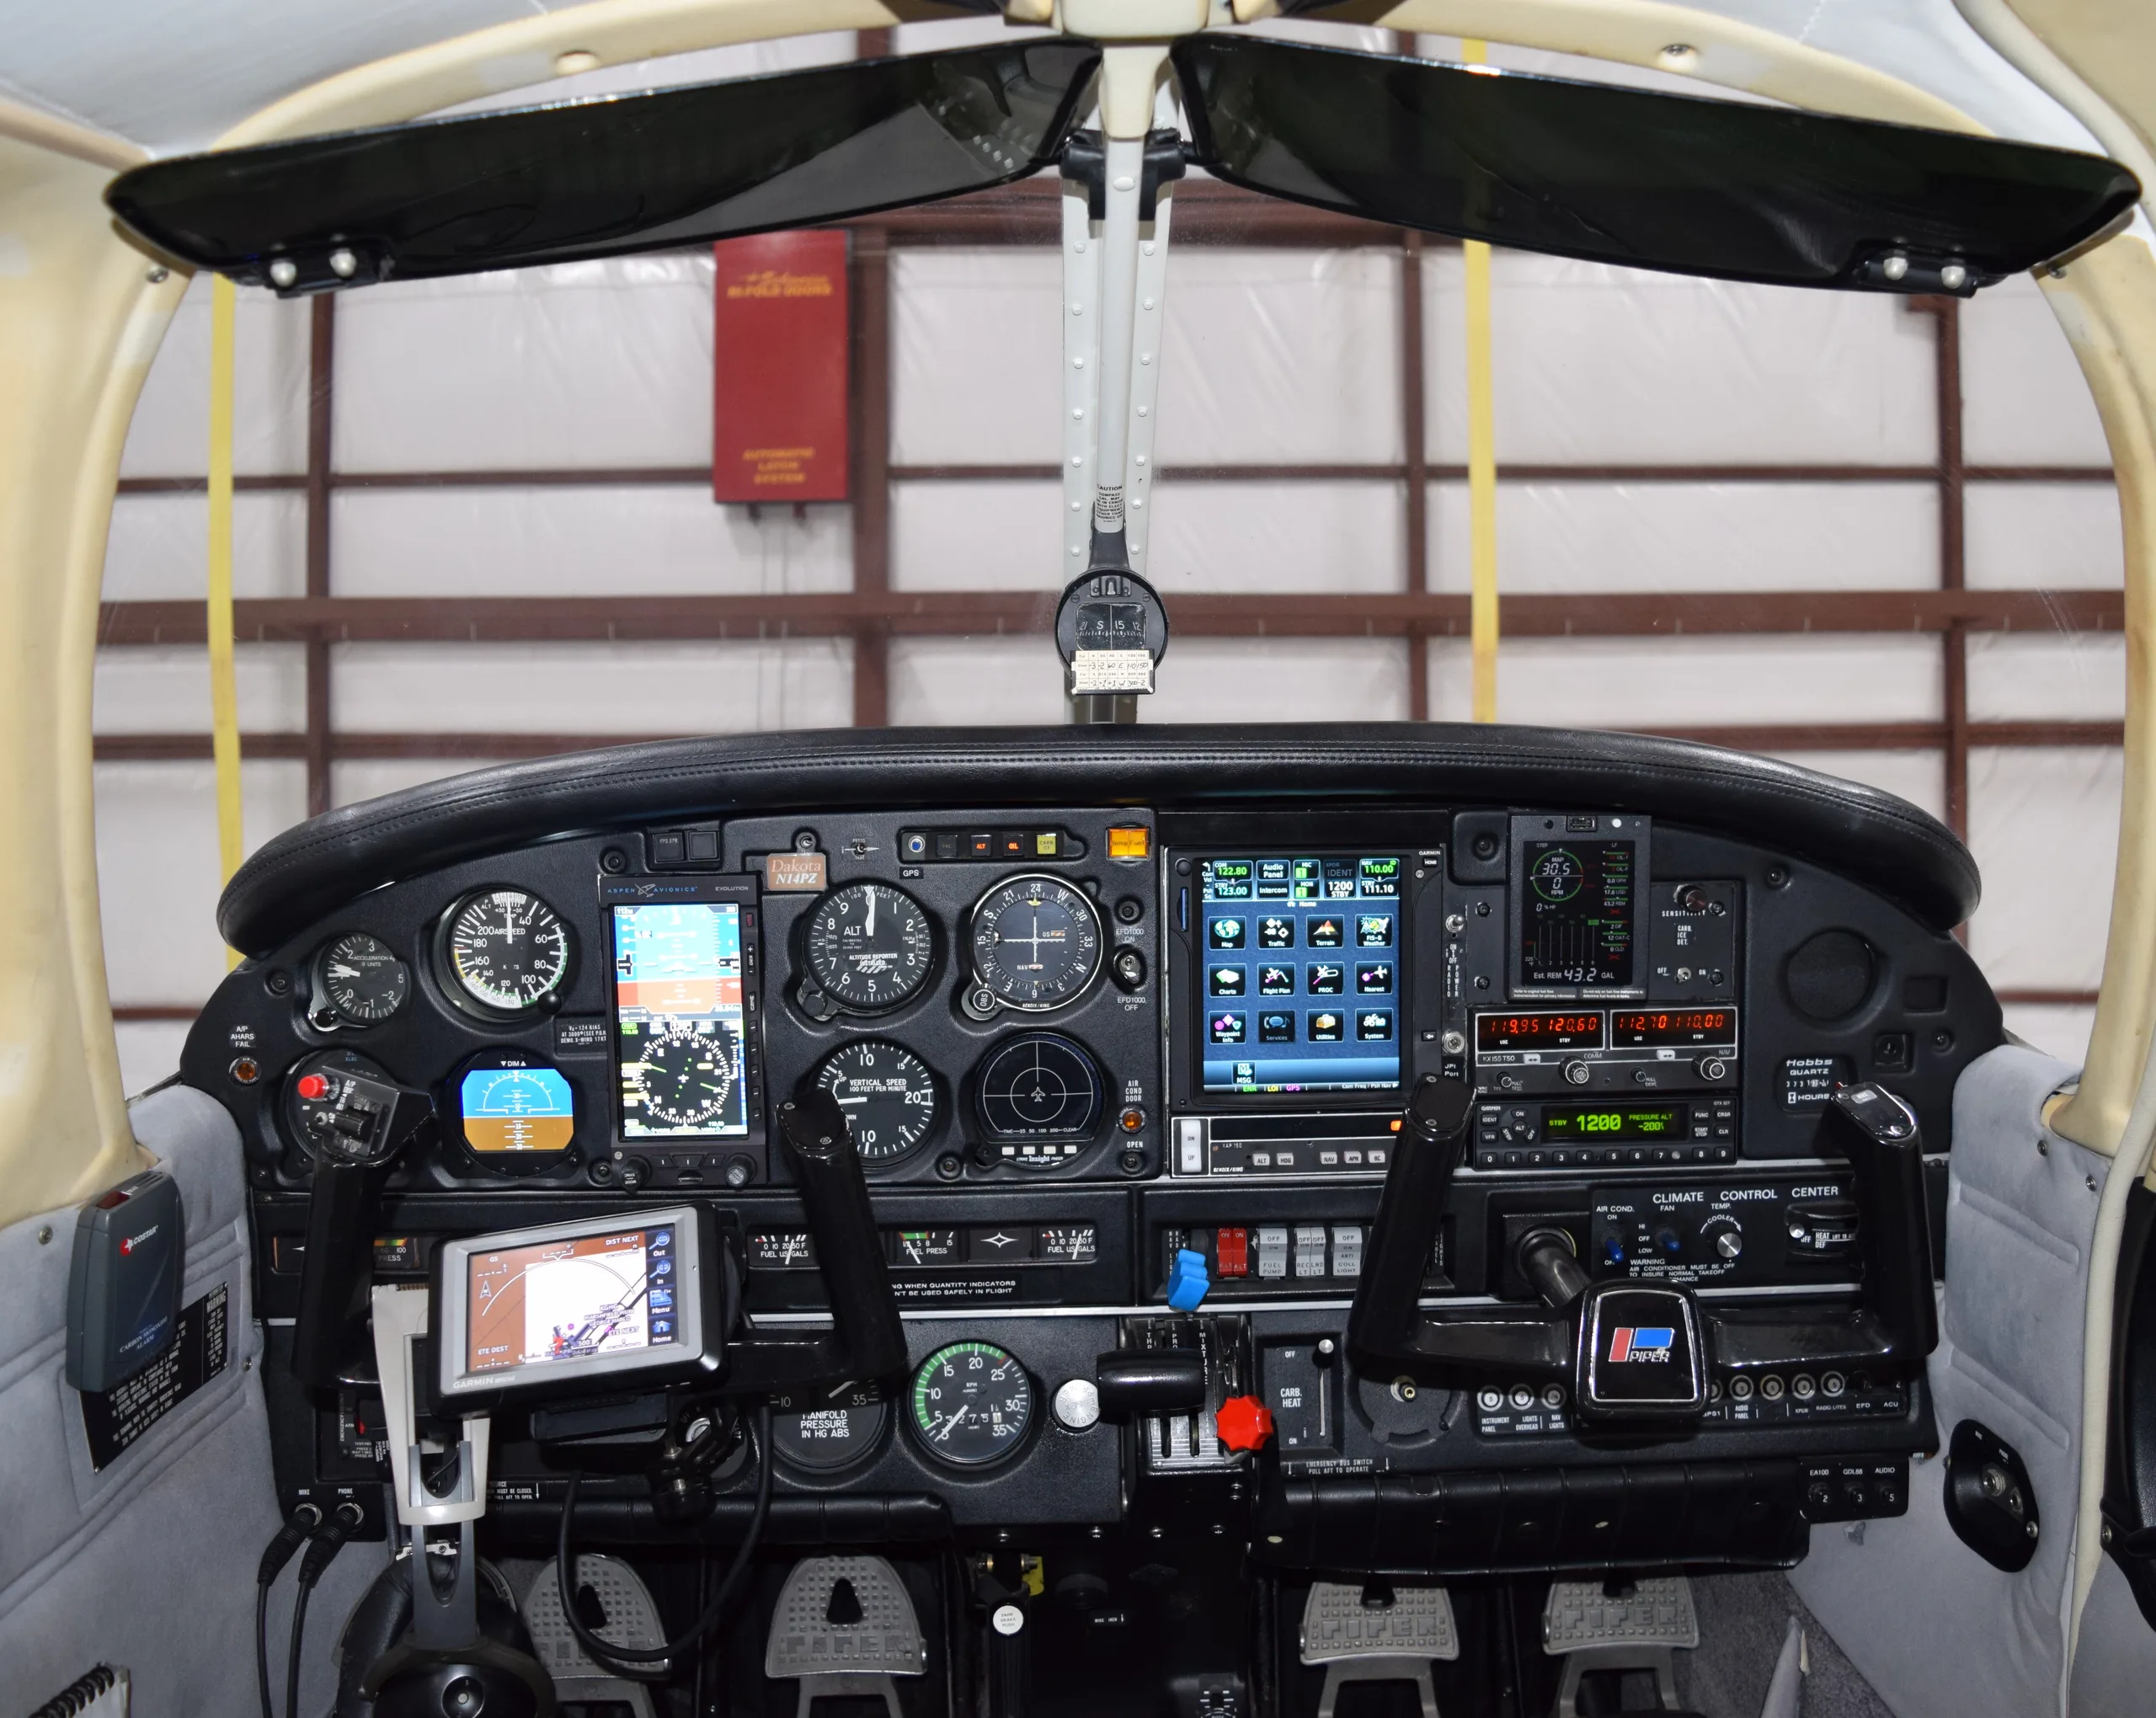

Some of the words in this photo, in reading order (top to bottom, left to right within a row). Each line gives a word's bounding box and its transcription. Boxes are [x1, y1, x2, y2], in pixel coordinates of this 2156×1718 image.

[742, 446, 815, 461] AUTOMATIC
[1097, 620, 1104, 630] S
[1114, 621, 1125, 630] 15
[771, 859, 822, 872] Dakota
[1364, 865, 1394, 874] 110.00
[1542, 862, 1571, 876] 30.5
[1217, 867, 1247, 876] 122.80
[1327, 868, 1353, 877] IDENT
[776, 872, 818, 884] N14PZ
[1030, 884, 1041, 893] 24
[1218, 887, 1247, 896] 123.00
[1328, 882, 1353, 891] 1200
[1364, 885, 1394, 894] 111.10
[519, 916, 531, 926] 40
[478, 926, 494, 936] 200
[843, 926, 862, 936] ALT
[473, 938, 488, 947] 180
[535, 934, 547, 944] 60
[475, 956, 490, 965] 160
[534, 959, 547, 969] 80
[521, 974, 536, 984] 100
[1563, 968, 1597, 982] 43.2
[979, 993, 989, 1006] OBS
[1491, 1018, 1540, 1033] 119.95
[1548, 1016, 1598, 1032] 120.60
[1619, 1015, 1668, 1031] 112.70
[1675, 1013, 1725, 1029] 110.00
[860, 1054, 874, 1066] 10
[1785, 1058, 1833, 1067] Hobbs
[1790, 1068, 1829, 1076] QUARTZ
[905, 1091, 921, 1104] 20
[1576, 1114, 1621, 1131] 1200
[1126, 1140, 1144, 1149] OPEN
[1028, 1155, 1050, 1164] Insight
[1652, 1192, 1705, 1204] CLIMATE
[1720, 1189, 1778, 1202] CONTROL
[1791, 1186, 1838, 1198] CENTER
[133, 1224, 158, 1245] COSTAR
[1815, 1231, 1830, 1240] HEAT
[606, 1236, 621, 1246] DIST
[622, 1235, 639, 1244] NEXT
[926, 1246, 947, 1255] PRESS
[653, 1334, 672, 1344] Home
[1629, 1350, 1670, 1363] PIPER
[969, 1357, 983, 1369] 20
[990, 1369, 1006, 1381] 25
[452, 1376, 494, 1390] GARMIN
[1280, 1387, 1303, 1397] CARB.
[1282, 1398, 1302, 1407] HEAT
[800, 1419, 848, 1429] PRESSURE
[801, 1429, 811, 1438] IN
[814, 1429, 827, 1438] HG
[830, 1428, 850, 1438] ABS
